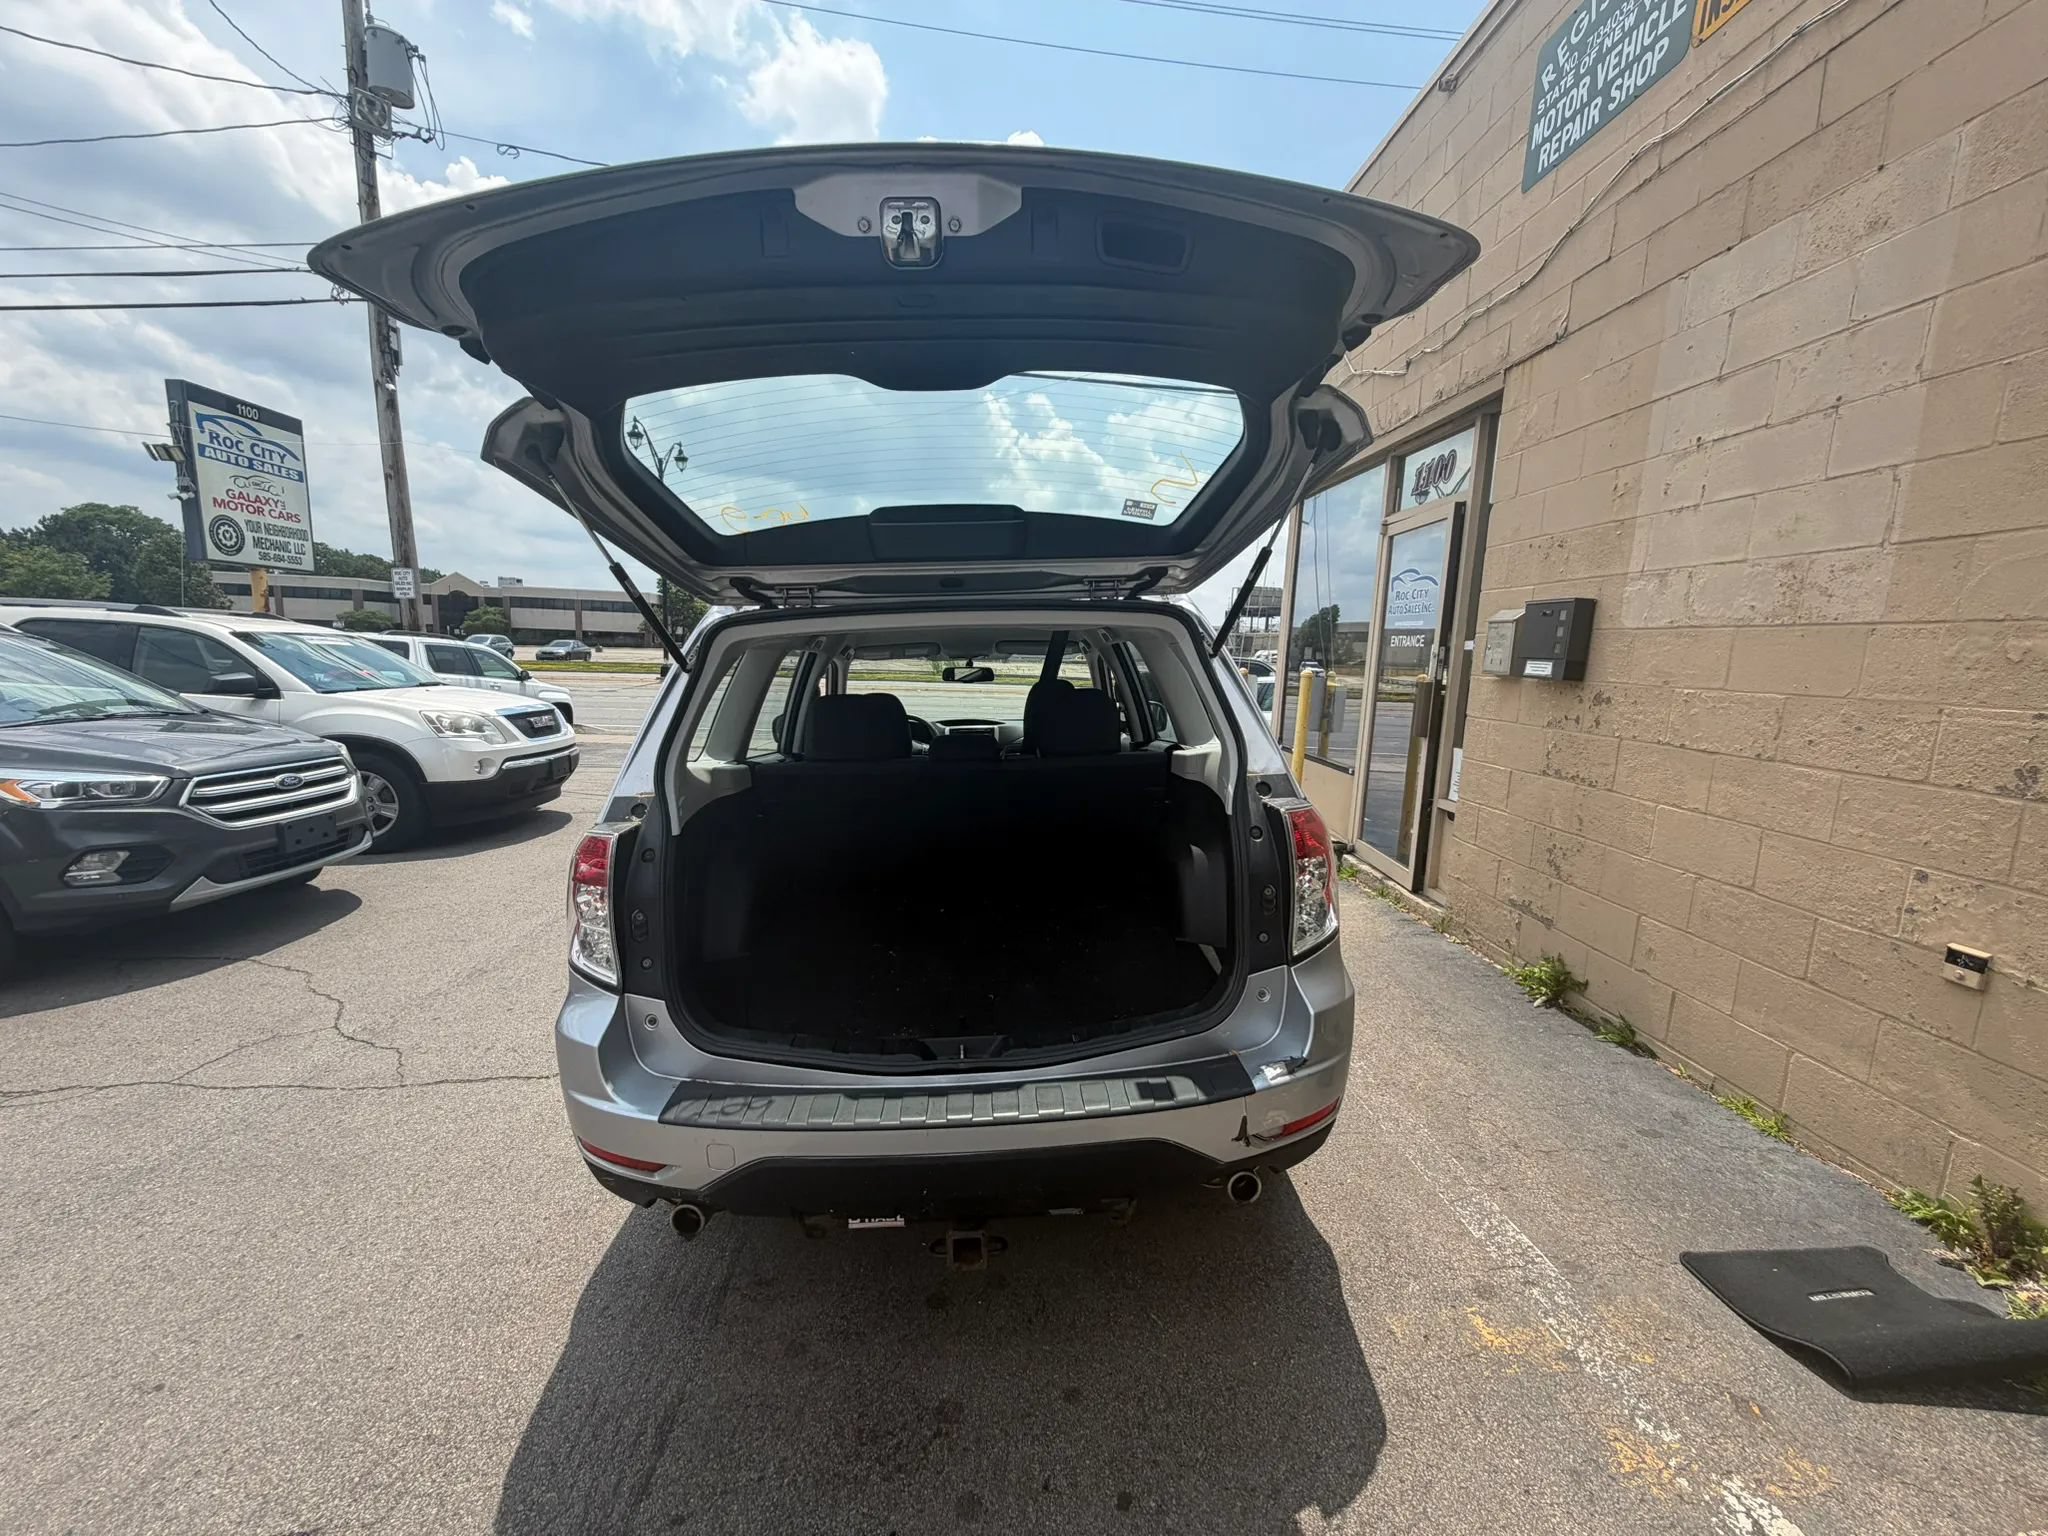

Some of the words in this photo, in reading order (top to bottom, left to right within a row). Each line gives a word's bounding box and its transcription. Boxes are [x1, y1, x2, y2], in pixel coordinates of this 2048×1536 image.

[1537, 69, 1576, 115] STATE
[1580, 46, 1599, 74] OF
[1602, 7, 1638, 53] NEW
[1563, 52, 1578, 76] NO.
[1531, 75, 1591, 151] MOTOR
[1597, 0, 1687, 91] VEHICLE
[1537, 96, 1602, 173] REPAIR
[1608, 36, 1670, 111] SHOP
[236, 404, 259, 420] 1100
[208, 431, 245, 453] ROC
[249, 442, 287, 464] CITY
[204, 446, 249, 467] AUTO
[252, 460, 299, 480] SALES
[1411, 448, 1457, 496] 1100
[212, 496, 266, 517] MOTOR
[268, 508, 302, 524] CARS
[225, 488, 280, 509] GALAXY
[244, 519, 263, 534] YOUR
[252, 535, 292, 554] MECHANIC
[293, 543, 306, 556] LLC
[1395, 590, 1410, 601] ROC
[1411, 588, 1429, 600] CITY
[1390, 634, 1425, 647] ENTRANCE
